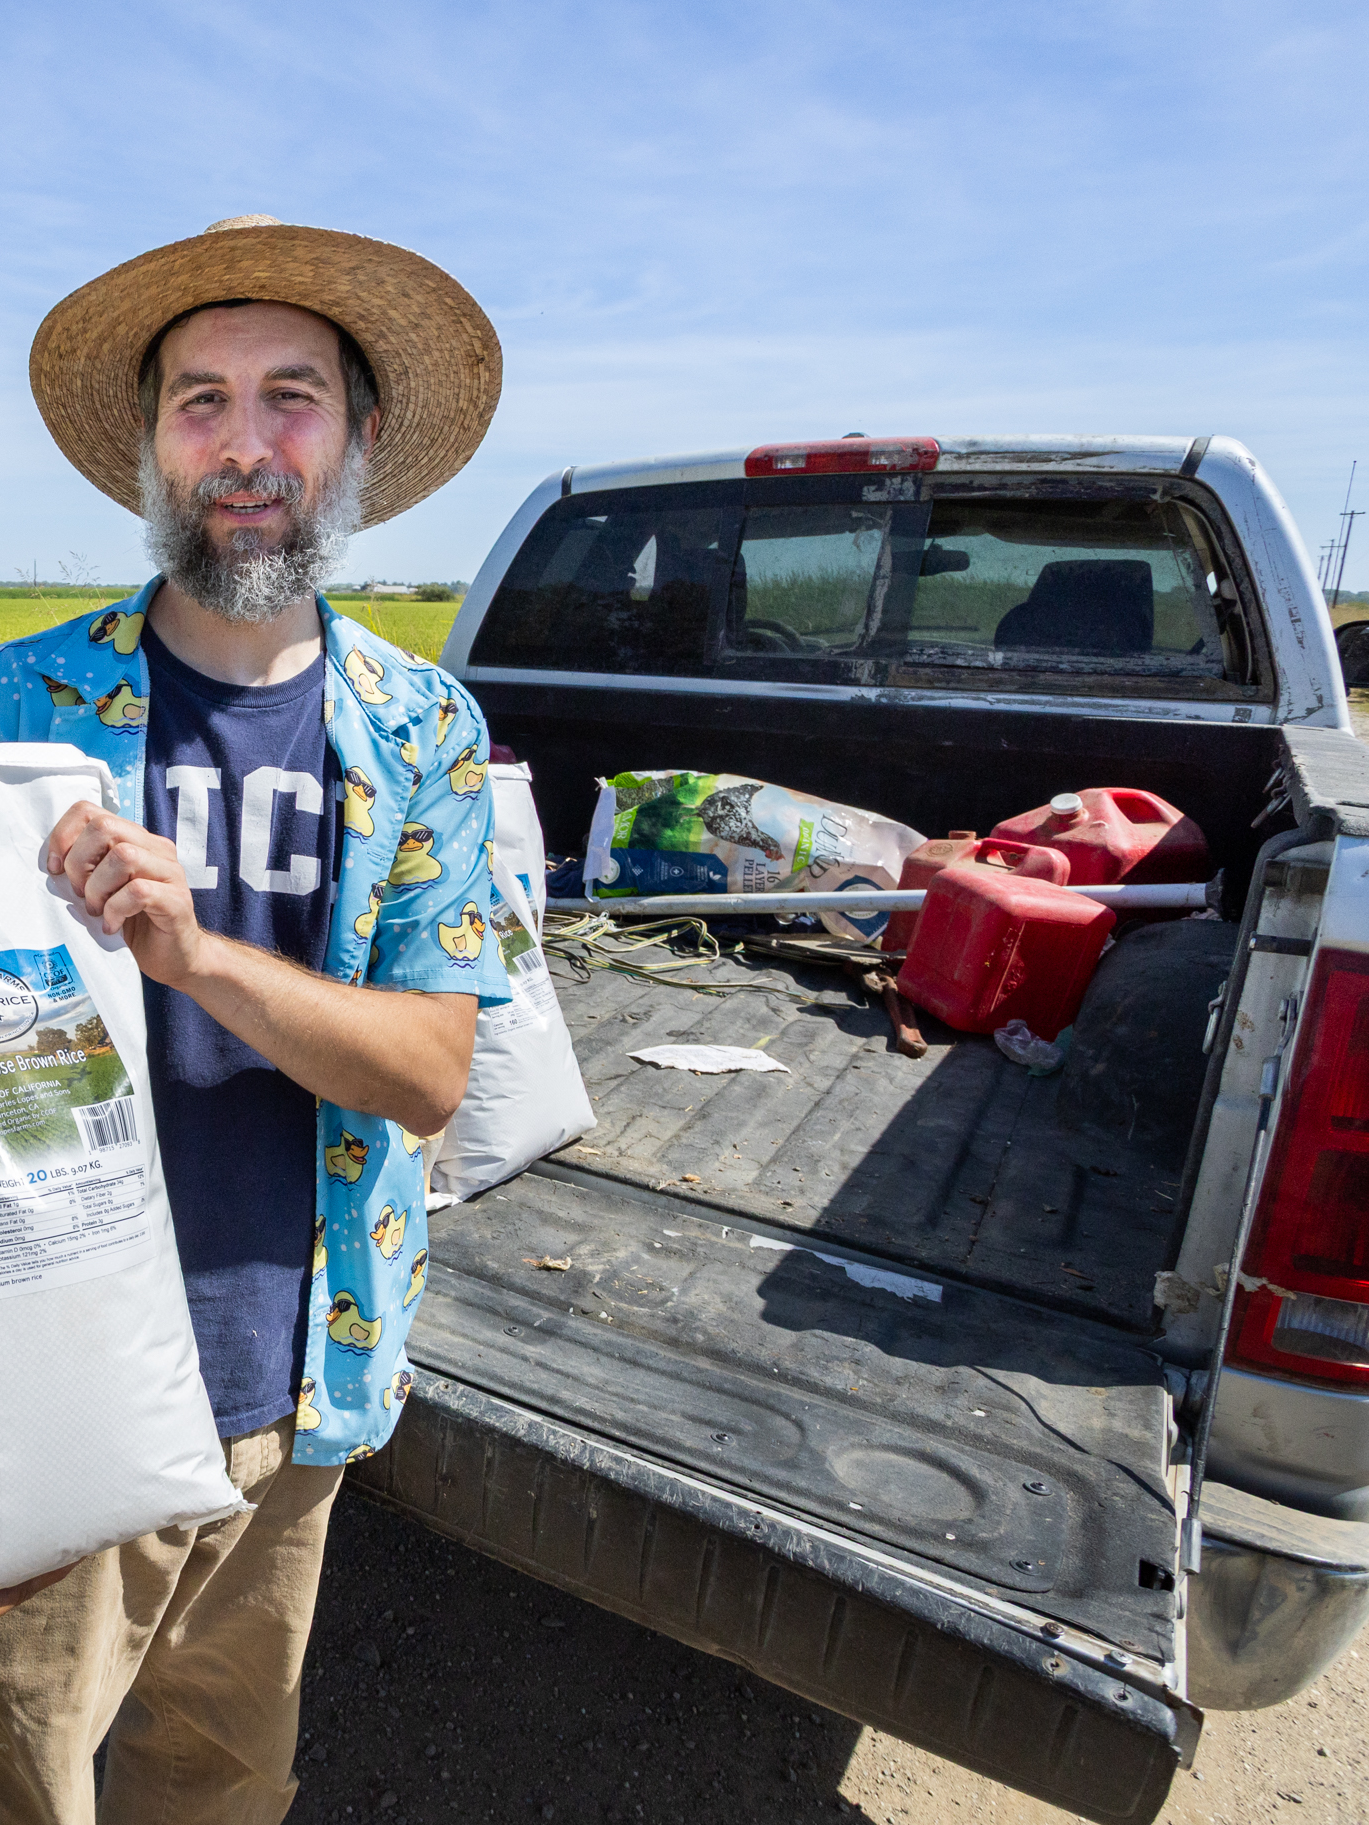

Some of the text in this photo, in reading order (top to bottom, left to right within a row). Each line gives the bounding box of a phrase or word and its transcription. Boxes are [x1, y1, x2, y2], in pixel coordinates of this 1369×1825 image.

[166, 765, 344, 904] IC
[755, 862, 766, 893] LAYER
[767, 870, 780, 883] 16
[499, 929, 513, 940] Rice
[47, 986, 76, 998] NON-GMO
[59, 992, 76, 1001] MORE
[15, 1053, 58, 1071] Brown
[56, 1048, 87, 1066] Rice
[12, 1079, 61, 1095] CALIFORNIA
[17, 1095, 39, 1106] Lopes
[54, 1088, 71, 1096] Sons
[29, 1103, 40, 1111] CA
[7, 1115, 32, 1128] Organic
[32, 1112, 40, 1121] by
[41, 1107, 57, 1117] CCOF
[27, 1170, 47, 1184] 20
[50, 1168, 69, 1179] LBS.
[71, 1165, 88, 1176] 9.07
[89, 1160, 103, 1170] KG.
[88, 1181, 116, 1191] Carbohydrate
[81, 1194, 95, 1202] Dietary
[81, 1220, 98, 1228] Protein
[19, 1245, 33, 1253] 0mcg
[48, 1238, 66, 1246] Calcium
[22, 1251, 38, 1259] 121mg
[11, 1276, 31, 1285] brown
